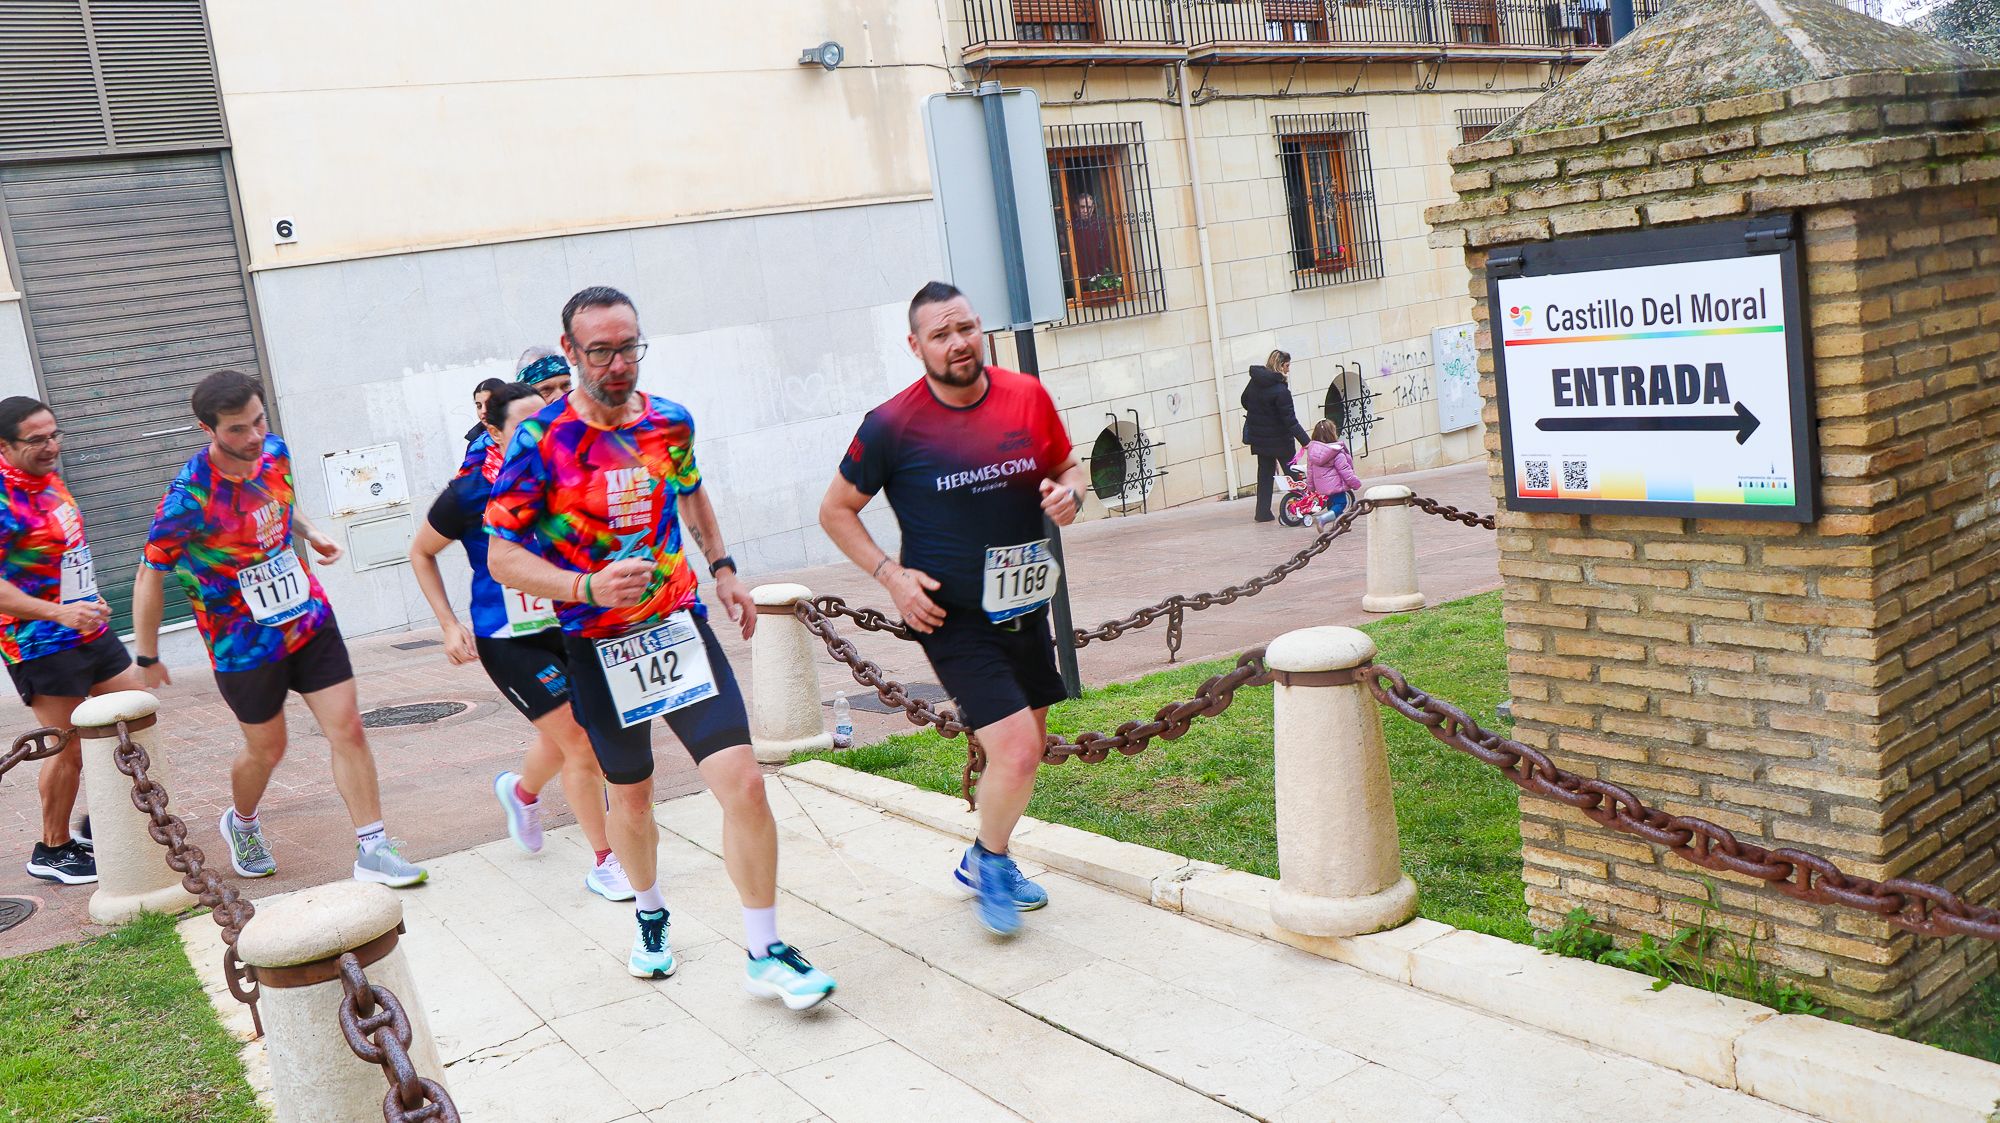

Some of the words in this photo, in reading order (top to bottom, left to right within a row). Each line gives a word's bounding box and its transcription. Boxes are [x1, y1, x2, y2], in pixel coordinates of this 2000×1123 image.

[276, 219, 293, 238] 6
[1545, 298, 1634, 332] Castillo
[1641, 294, 1682, 326] Del
[1690, 287, 1767, 323] Moral
[1551, 362, 1730, 407] ENTRADA
[253, 572, 299, 608] 1177
[996, 564, 1049, 600] 1169
[630, 650, 684, 692] 142
